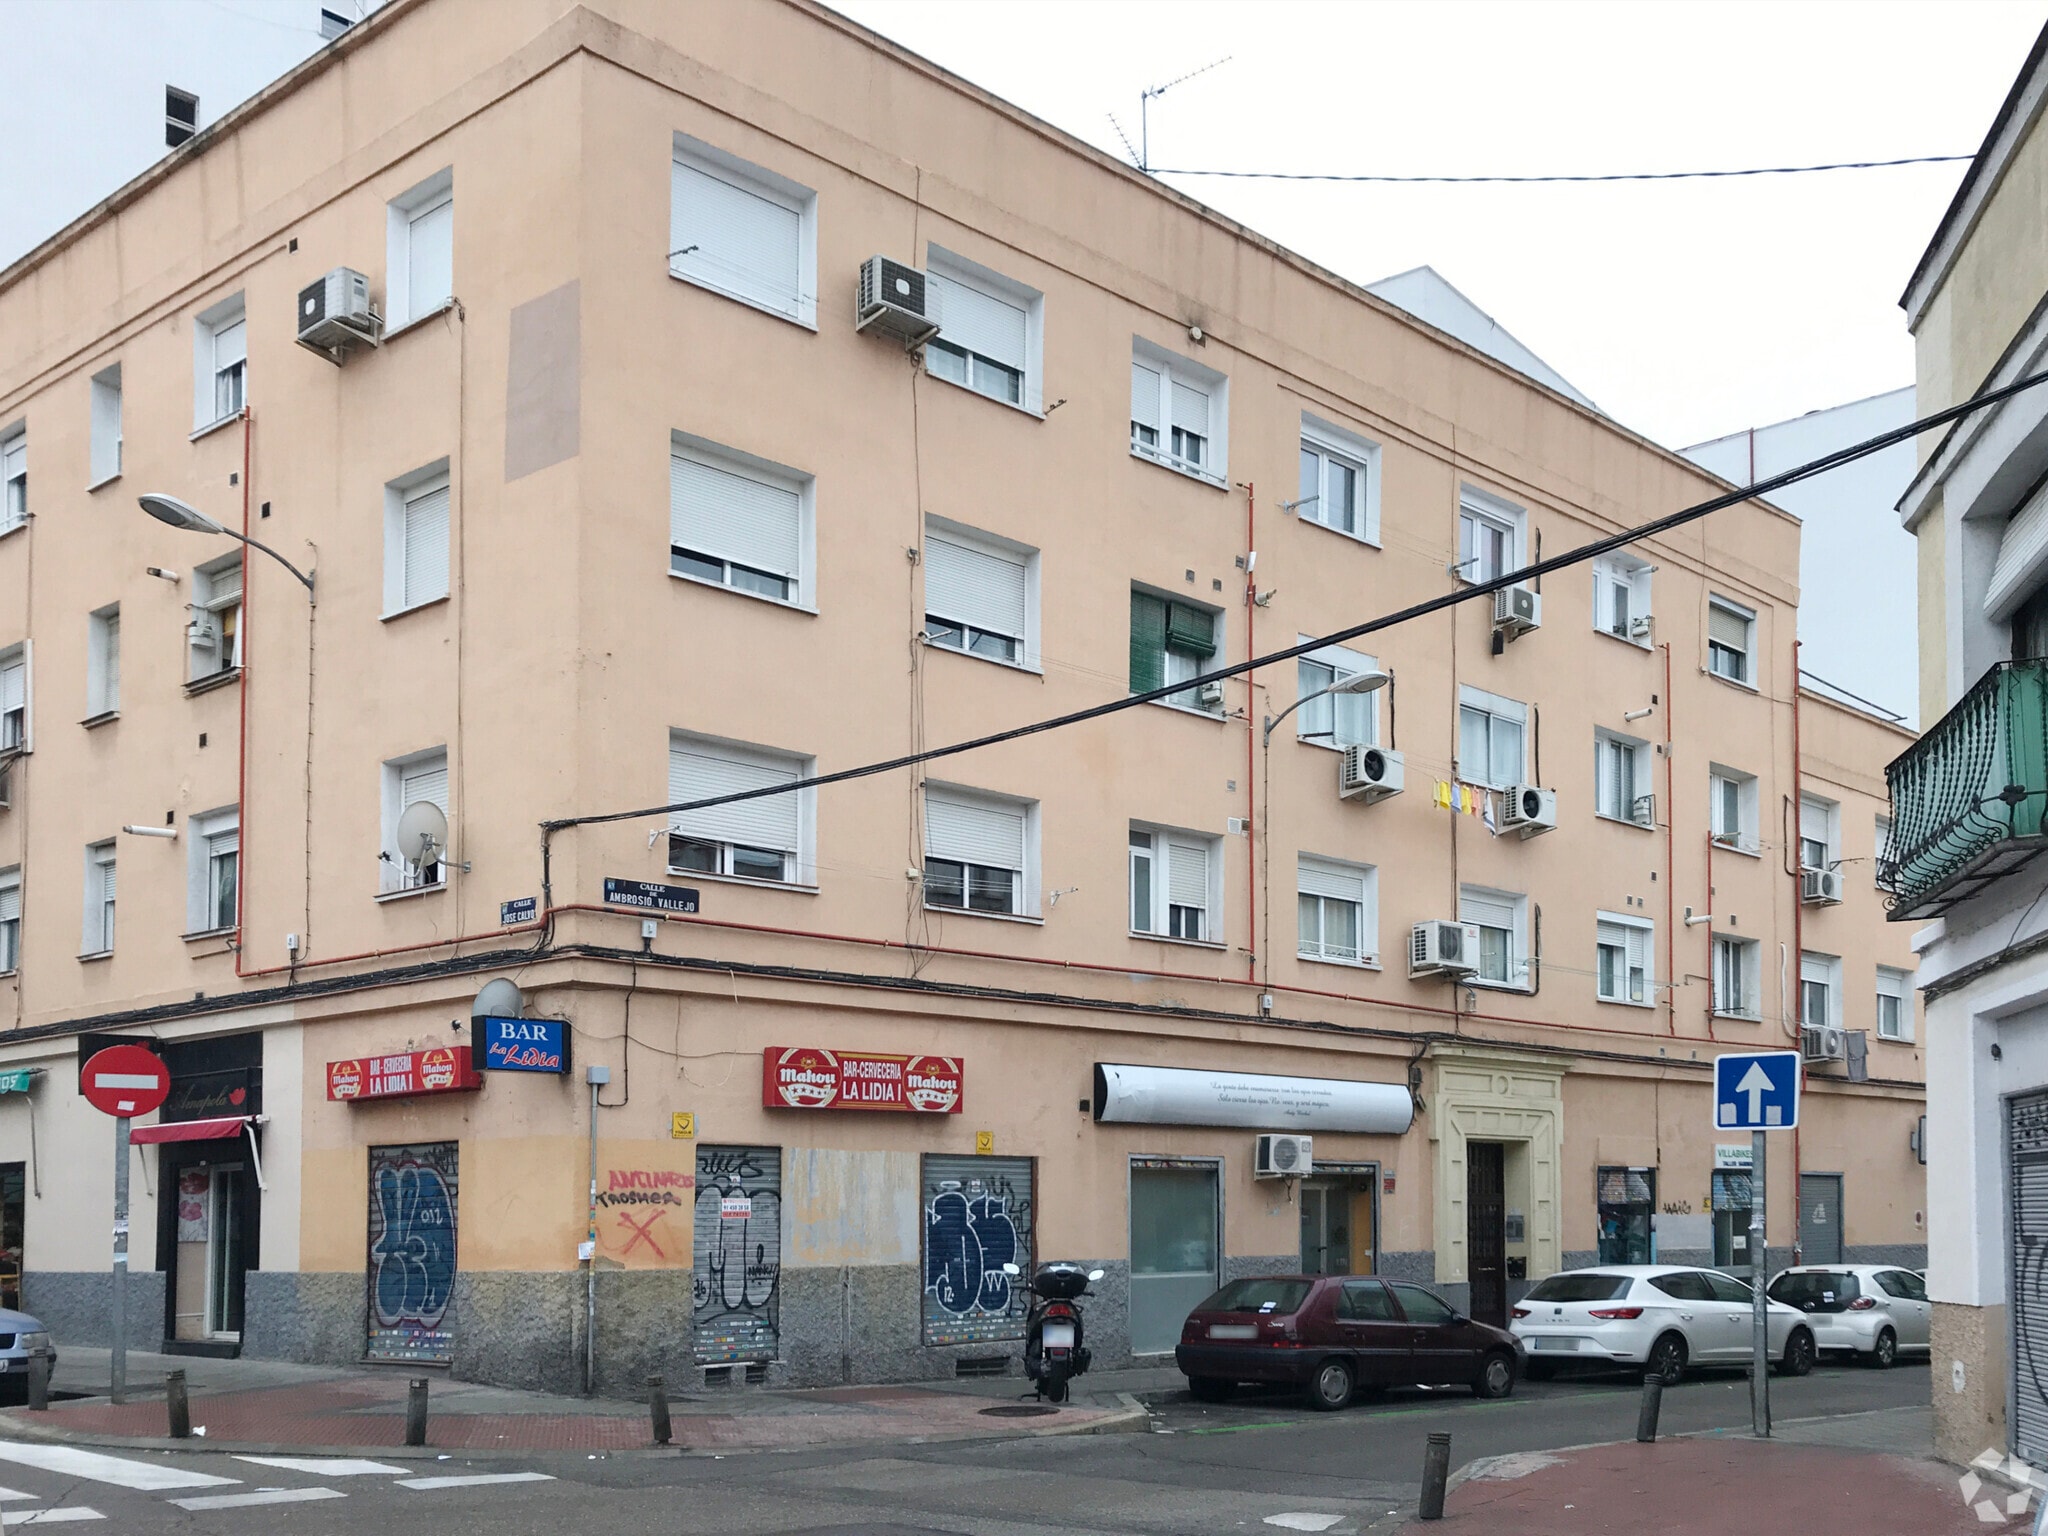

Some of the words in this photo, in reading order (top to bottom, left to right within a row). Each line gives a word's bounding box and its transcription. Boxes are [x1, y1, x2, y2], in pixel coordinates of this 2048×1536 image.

[639, 883, 666, 893] CALLE
[512, 899, 532, 909] CALLE
[658, 897, 695, 913] VALLEJO
[500, 1023, 548, 1041] BAR
[489, 1042, 507, 1055] La
[504, 1044, 559, 1068] Lidia
[422, 1063, 453, 1075] Mahou
[780, 1068, 836, 1084] Mahou
[843, 1060, 902, 1080] BAR-CERVECERIA
[332, 1073, 360, 1085] Mahou
[369, 1078, 382, 1094] LA
[384, 1075, 407, 1092] LIDIA
[908, 1074, 957, 1090] Mahou
[843, 1081, 859, 1100] LA
[862, 1082, 895, 1101] LIDIA
[897, 1085, 902, 1101] I
